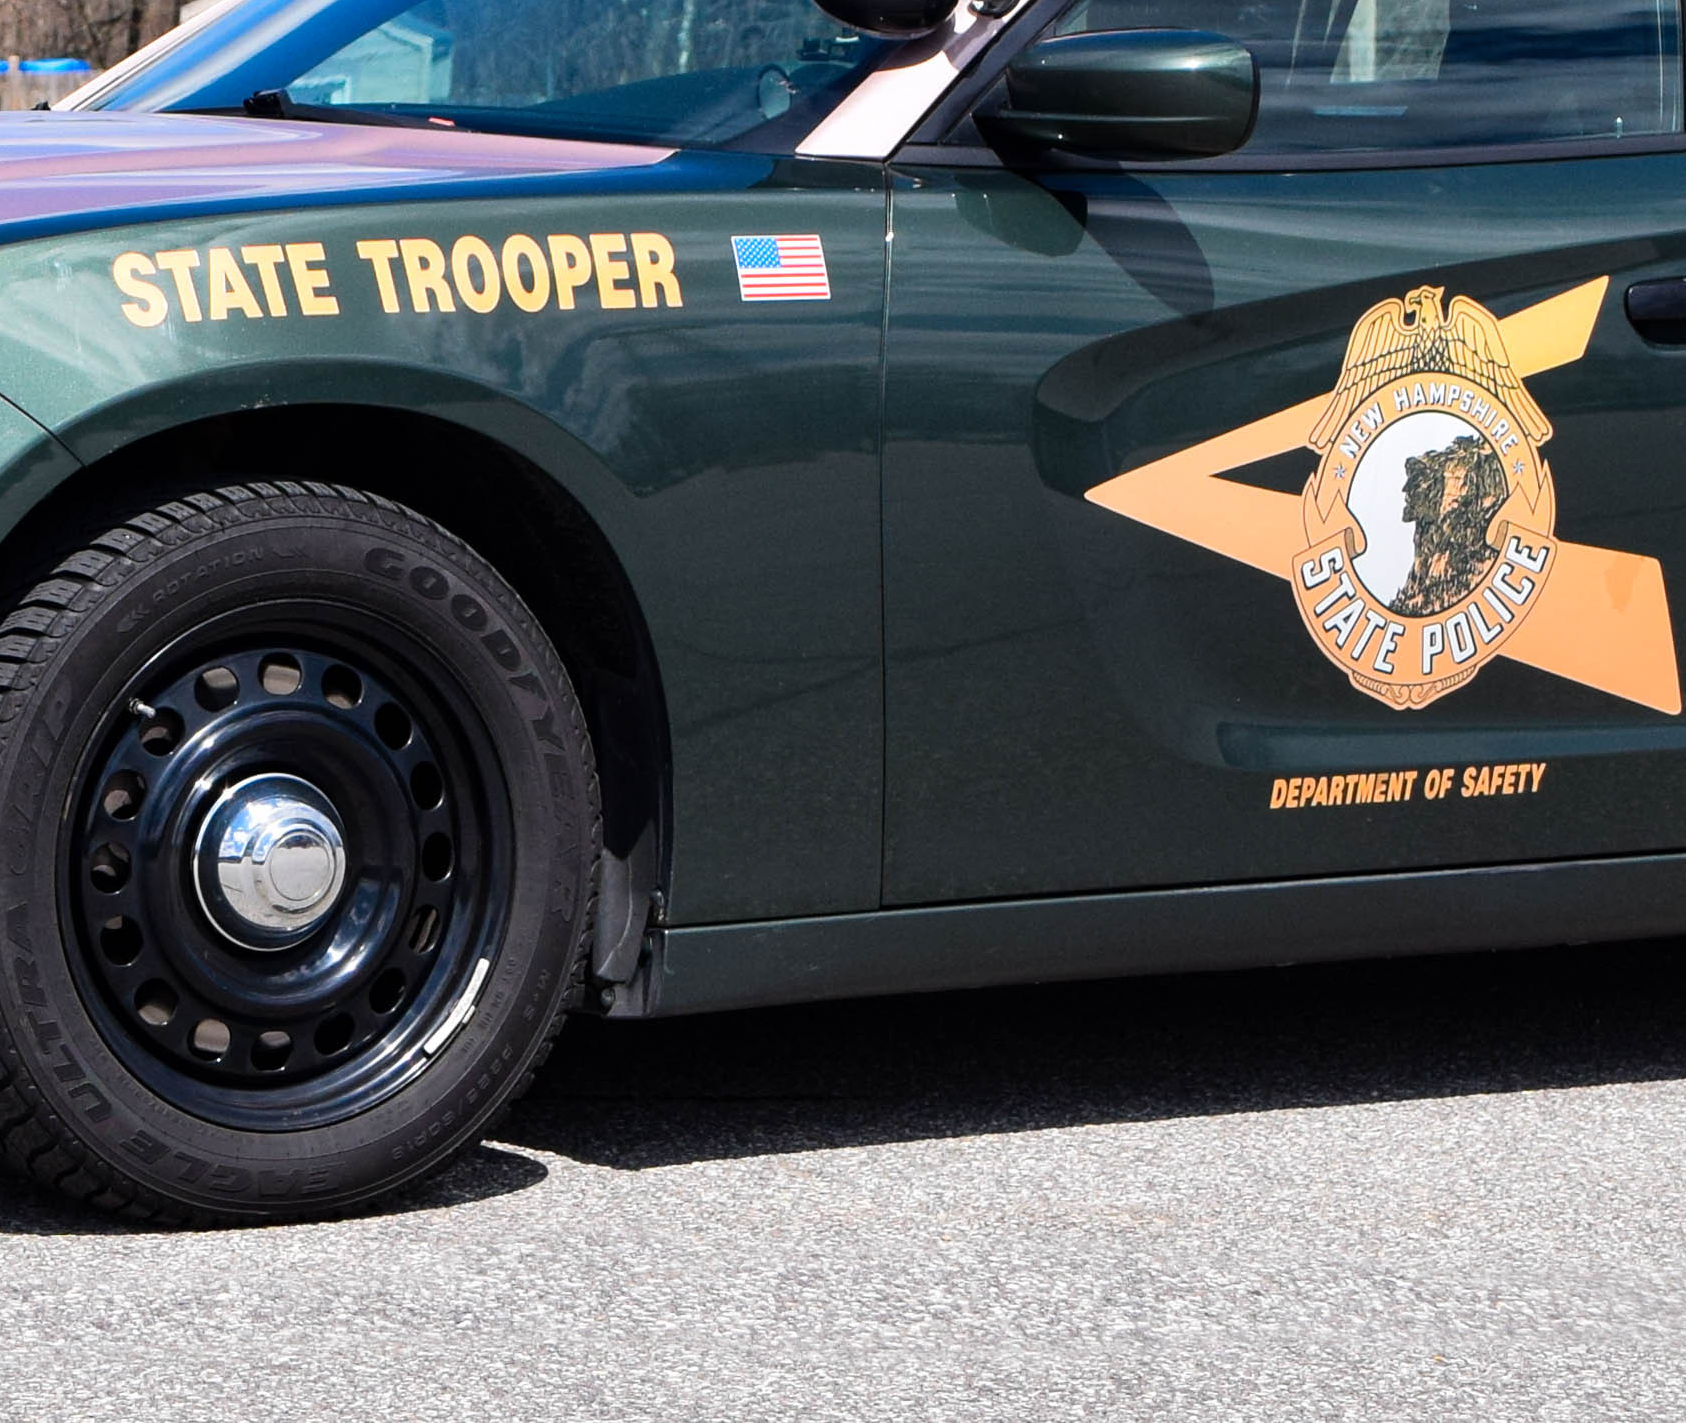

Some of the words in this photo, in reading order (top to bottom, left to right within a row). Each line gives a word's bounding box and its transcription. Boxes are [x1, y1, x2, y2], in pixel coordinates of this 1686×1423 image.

[112, 242, 340, 328] STATE
[356, 232, 683, 315] TROOPER
[1339, 402, 1385, 460] NEW
[1392, 382, 1519, 456] HAMPSHIRE
[151, 545, 263, 602] ROTATION
[1300, 546, 1406, 675] STATE
[1421, 535, 1550, 675] POLICE
[1269, 771, 1418, 809] DEPARTMENT
[1424, 768, 1455, 800] OF
[1461, 762, 1546, 797] SAFETY
[7, 903, 112, 1124] ULTRA
